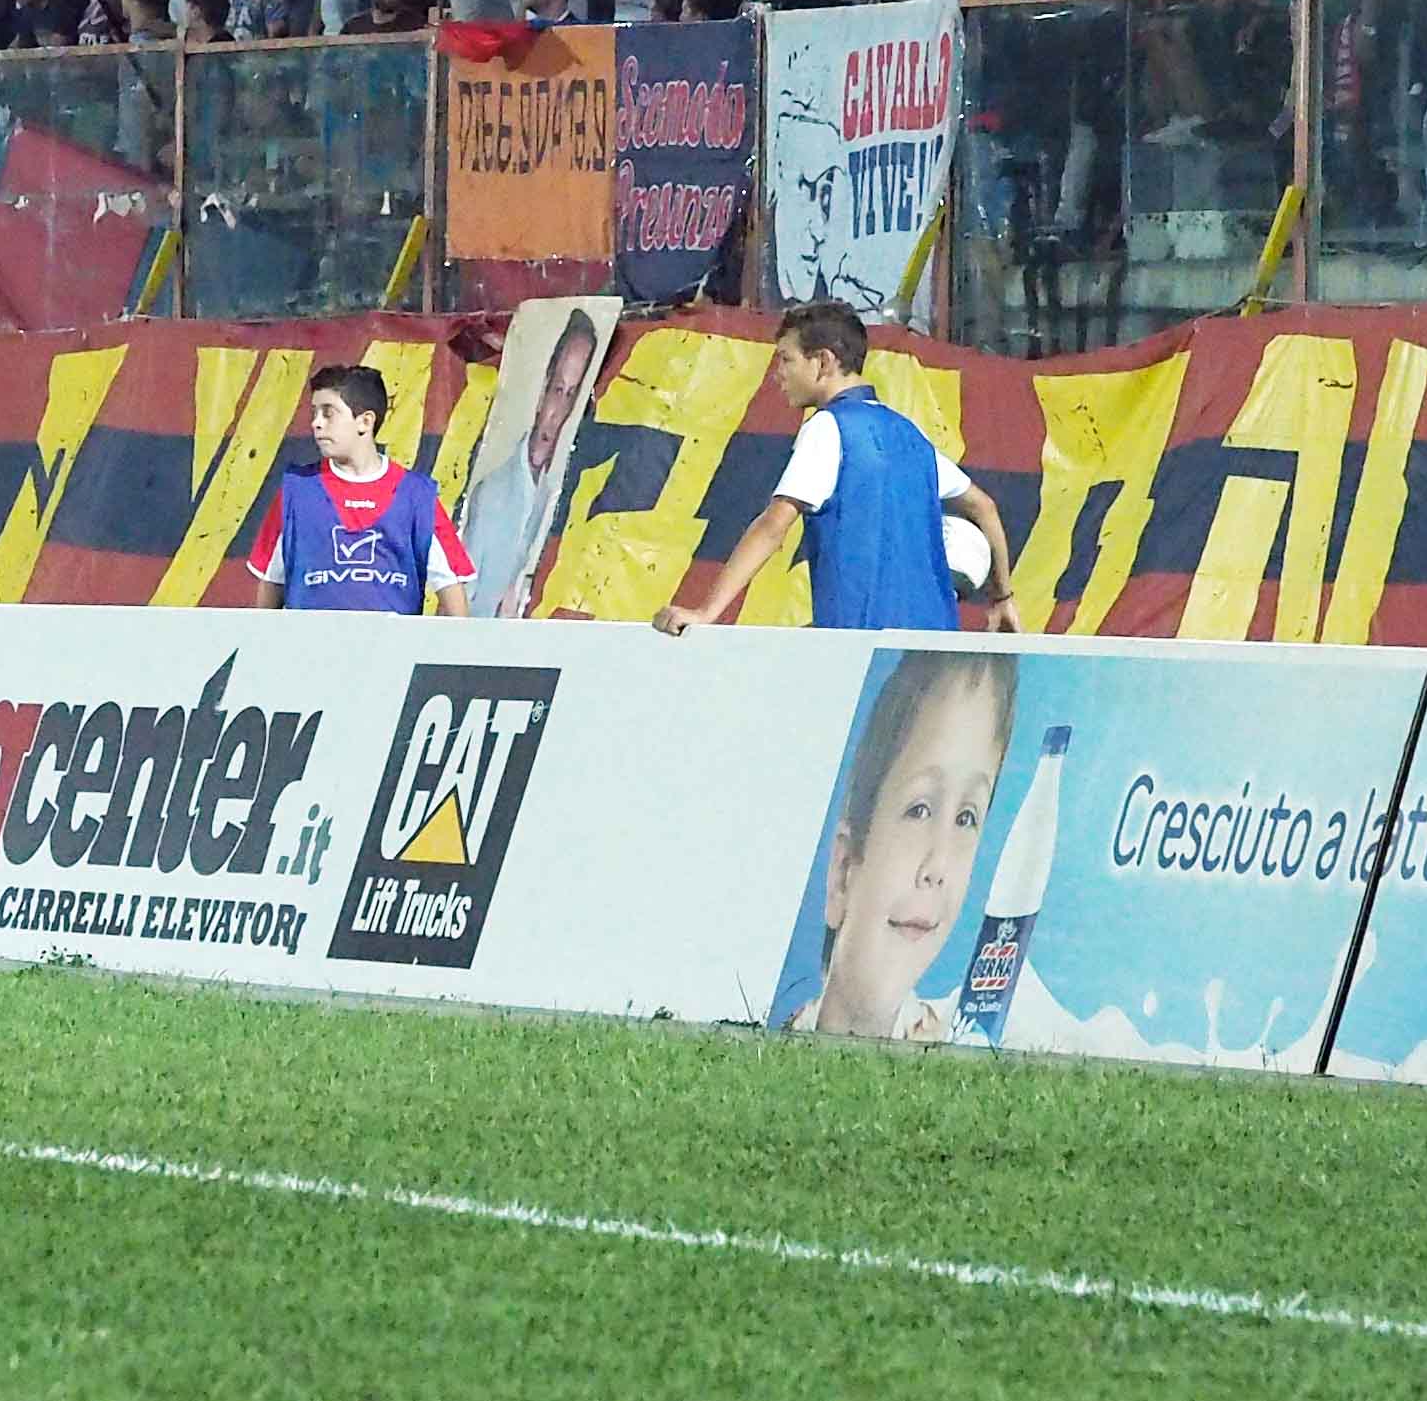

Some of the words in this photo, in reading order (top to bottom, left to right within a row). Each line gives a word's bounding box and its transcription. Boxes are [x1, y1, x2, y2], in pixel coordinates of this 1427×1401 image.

[843, 31, 951, 142] CAVALLO
[304, 567, 408, 588] GIVOVA
[380, 694, 534, 866] CAT
[1112, 774, 1313, 879] Cresciuto
[1315, 810, 1348, 881] a
[142, 894, 308, 955] ELEVATORI
[351, 876, 398, 933] Lift
[395, 879, 473, 940] Trucks
[972, 956, 1014, 980] BERNA
